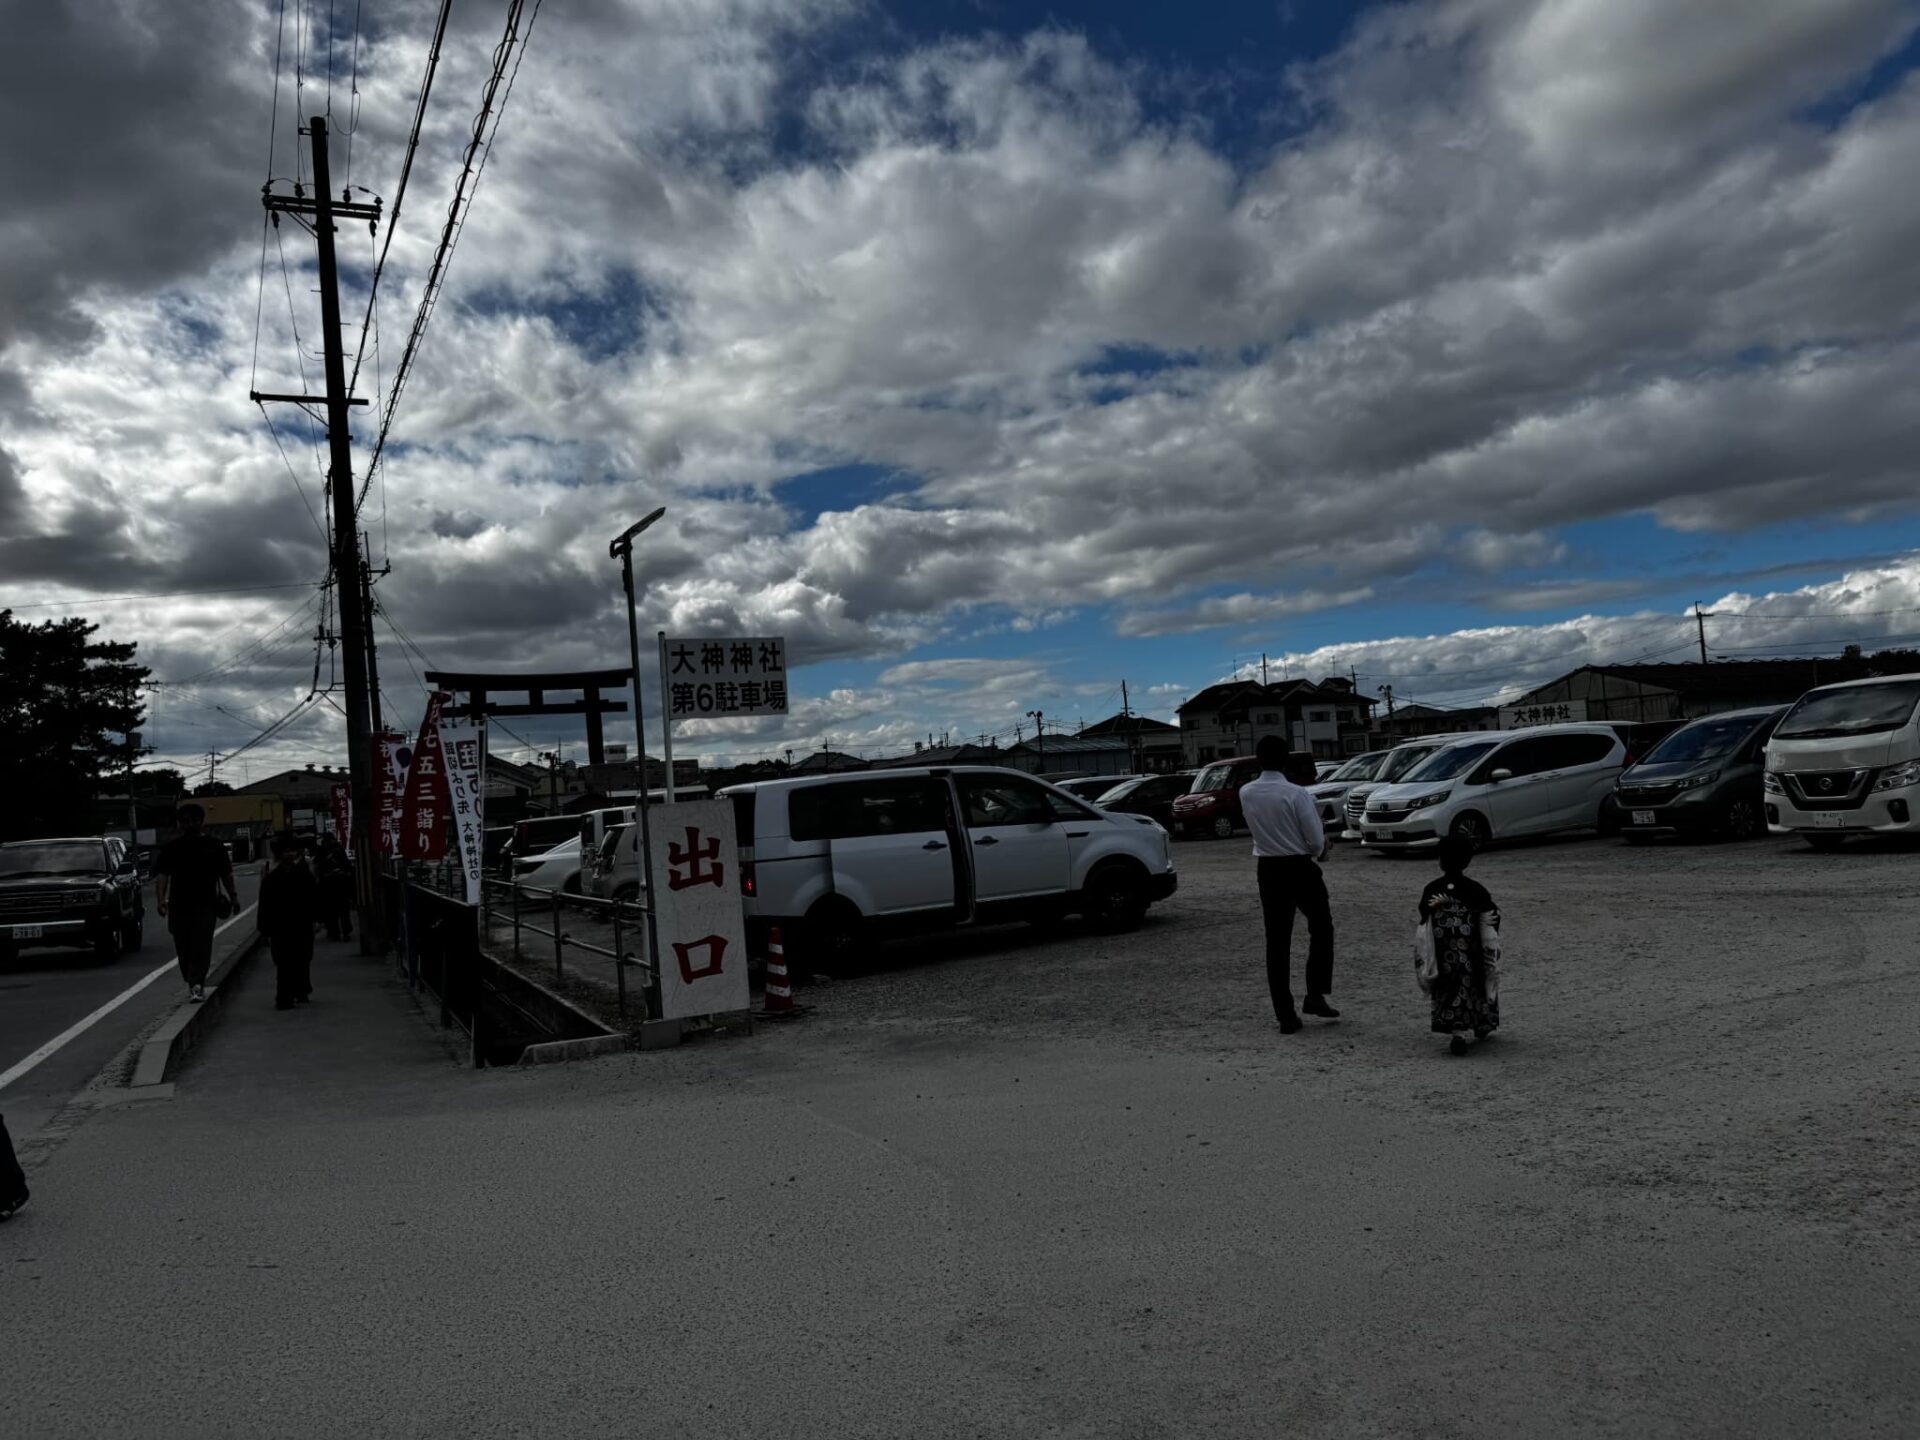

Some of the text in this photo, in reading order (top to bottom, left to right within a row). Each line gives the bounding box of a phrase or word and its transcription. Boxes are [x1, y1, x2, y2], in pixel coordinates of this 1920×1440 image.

[671, 642, 782, 674] 大神神社
[671, 680, 786, 713] 第6駐車場
[1514, 704, 1571, 723] 大神神社
[668, 826, 728, 984] 出口
